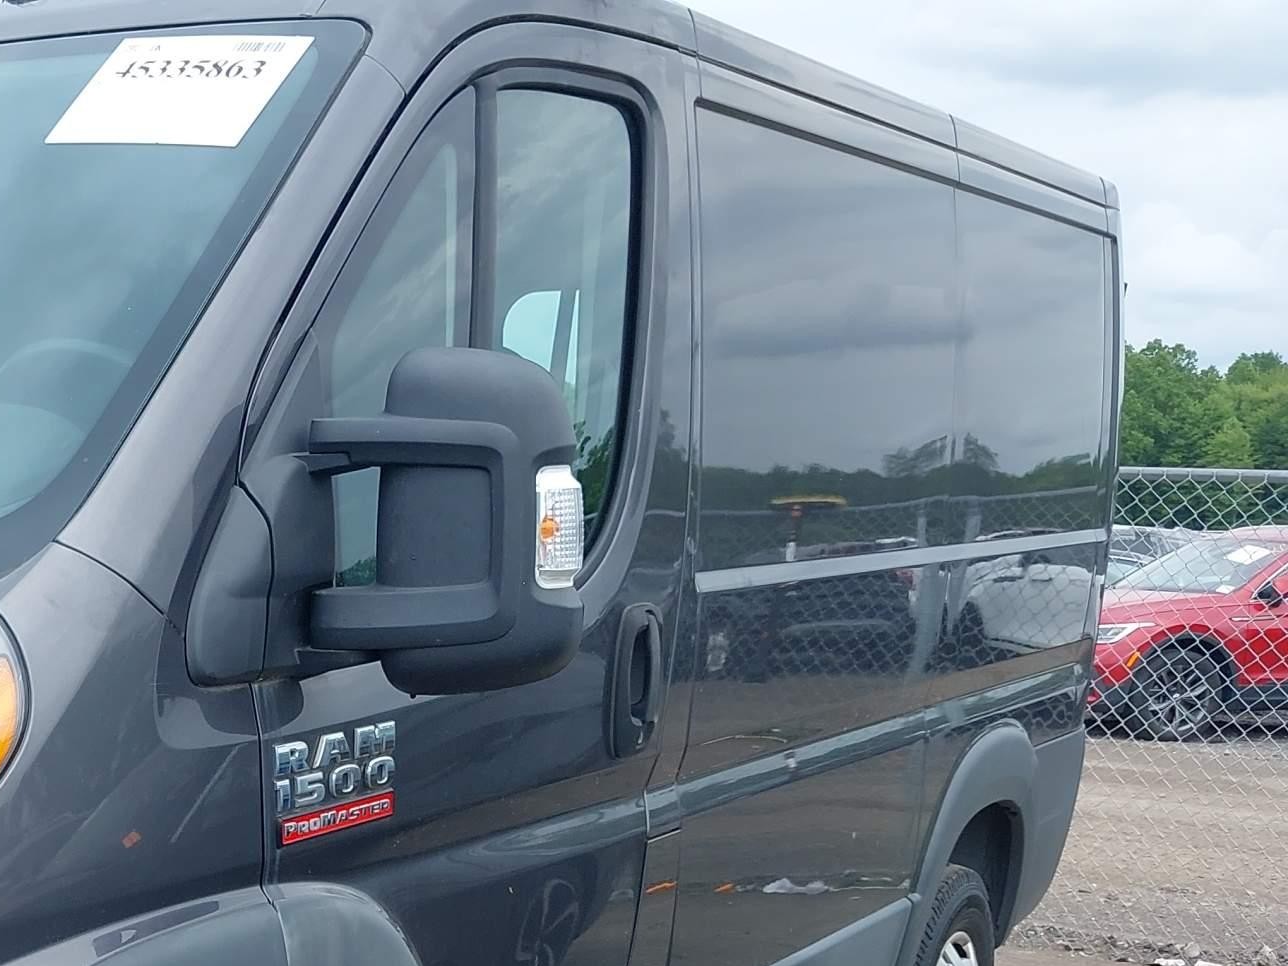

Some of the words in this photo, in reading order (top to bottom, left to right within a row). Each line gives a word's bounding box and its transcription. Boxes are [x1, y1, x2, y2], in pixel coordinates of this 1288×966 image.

[116, 59, 267, 78] 45335863
[274, 720, 396, 777] RAM
[274, 756, 396, 812] 1500
